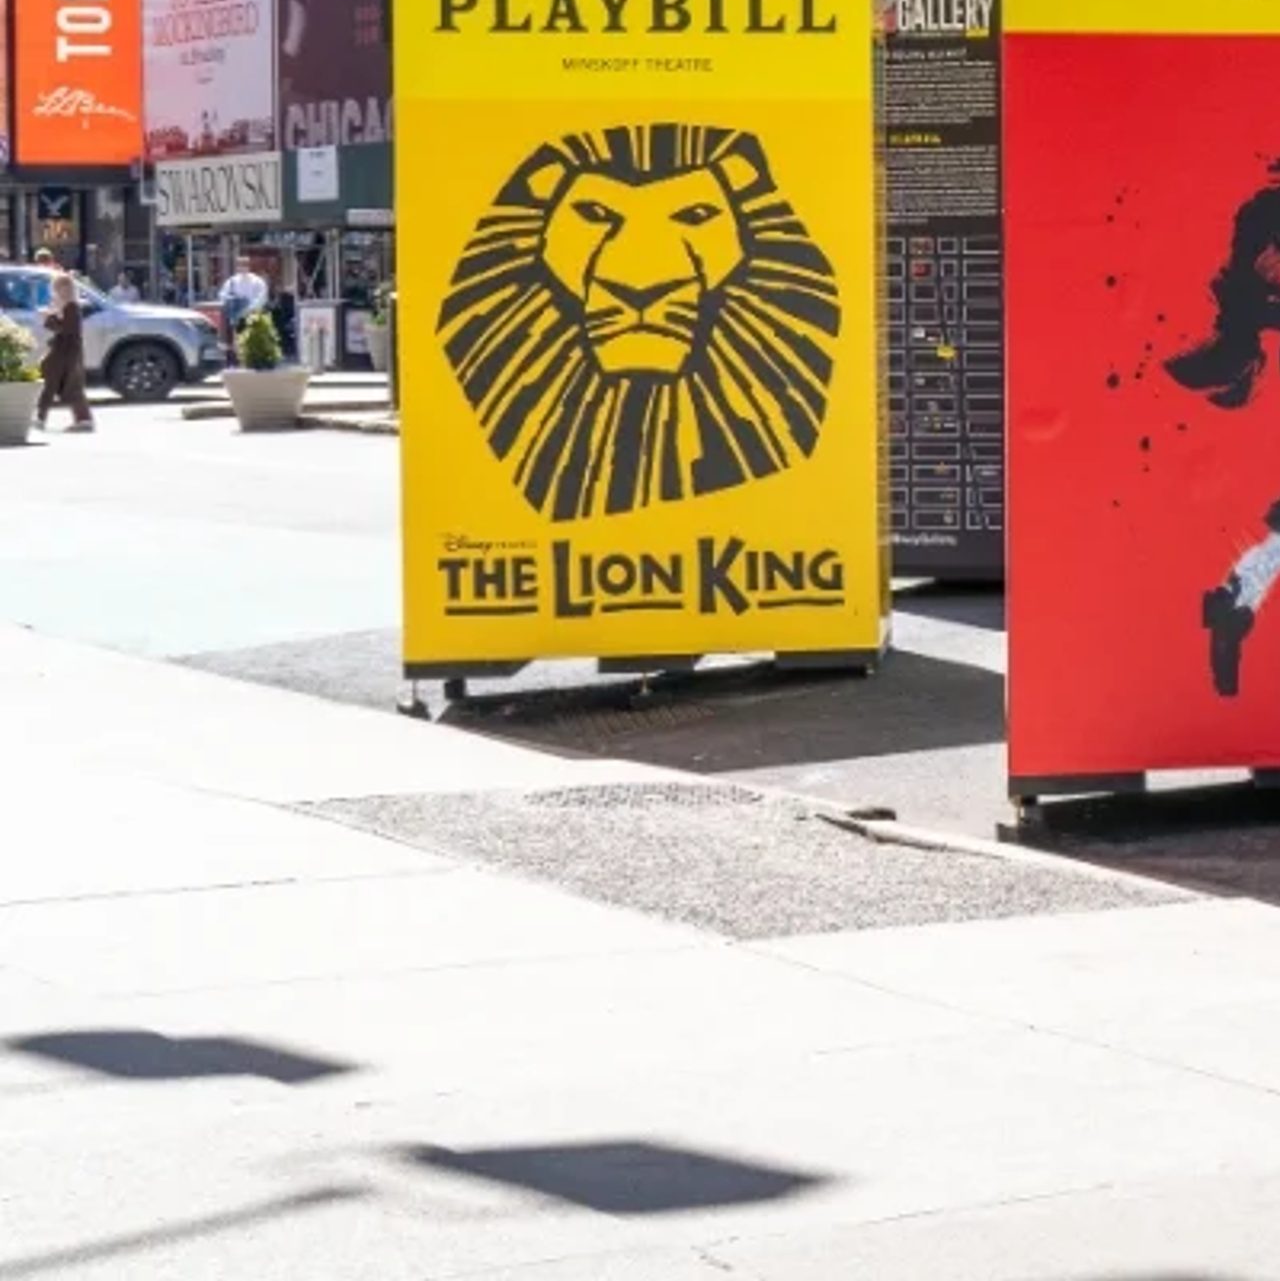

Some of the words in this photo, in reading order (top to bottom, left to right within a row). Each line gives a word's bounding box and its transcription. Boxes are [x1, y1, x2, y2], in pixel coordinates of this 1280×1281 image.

[561, 57, 642, 73] MINSKOFF
[646, 57, 714, 73] THEATRE
[158, 161, 280, 216] SWAROVSKI
[437, 556, 539, 601] THE
[552, 539, 685, 620] LION
[697, 536, 846, 618] KING
